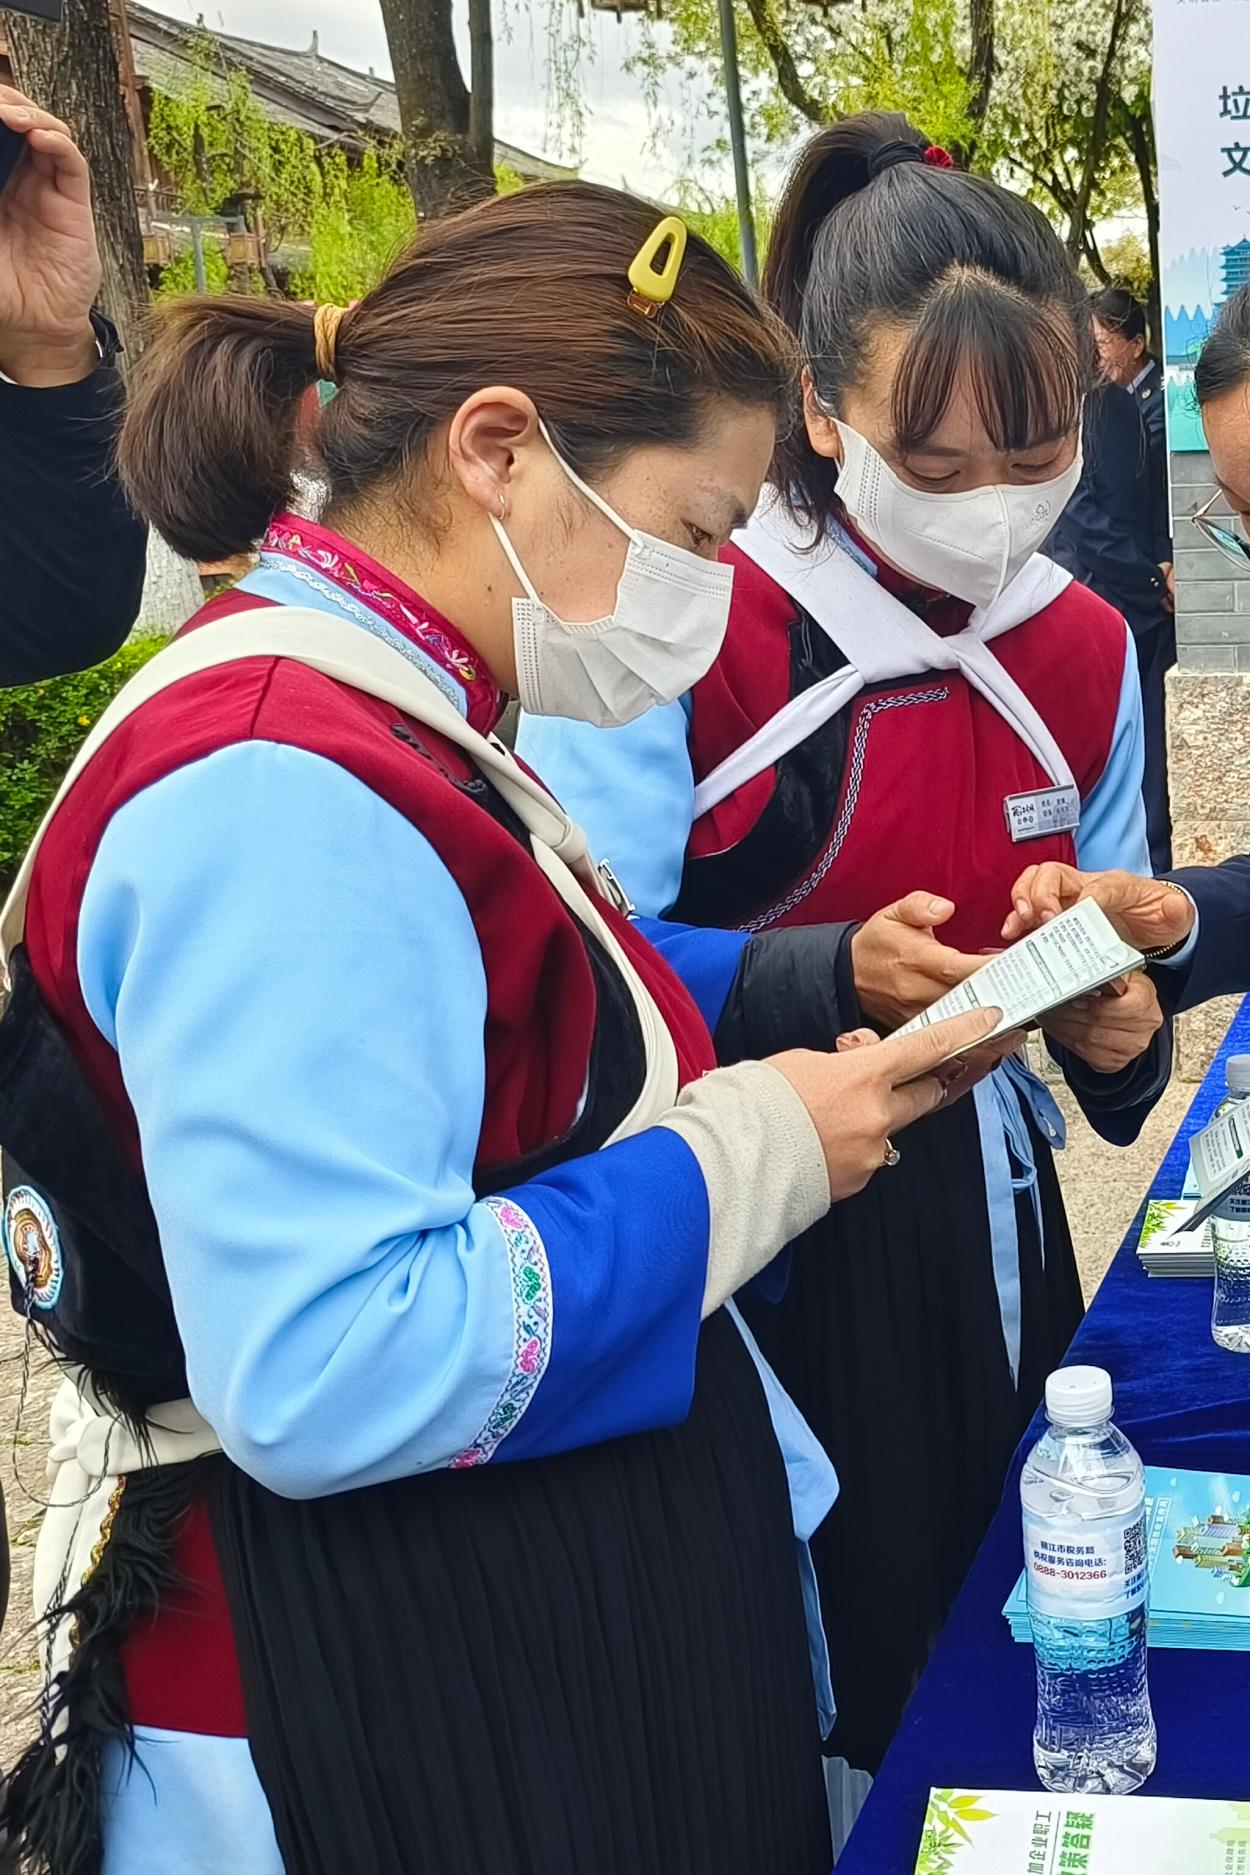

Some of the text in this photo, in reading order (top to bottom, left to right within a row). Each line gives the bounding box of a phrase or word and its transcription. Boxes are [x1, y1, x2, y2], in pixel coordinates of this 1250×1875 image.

[1033, 1562, 1107, 1580] 0888-3012366
[1027, 1810, 1052, 1875] 加企业职工
